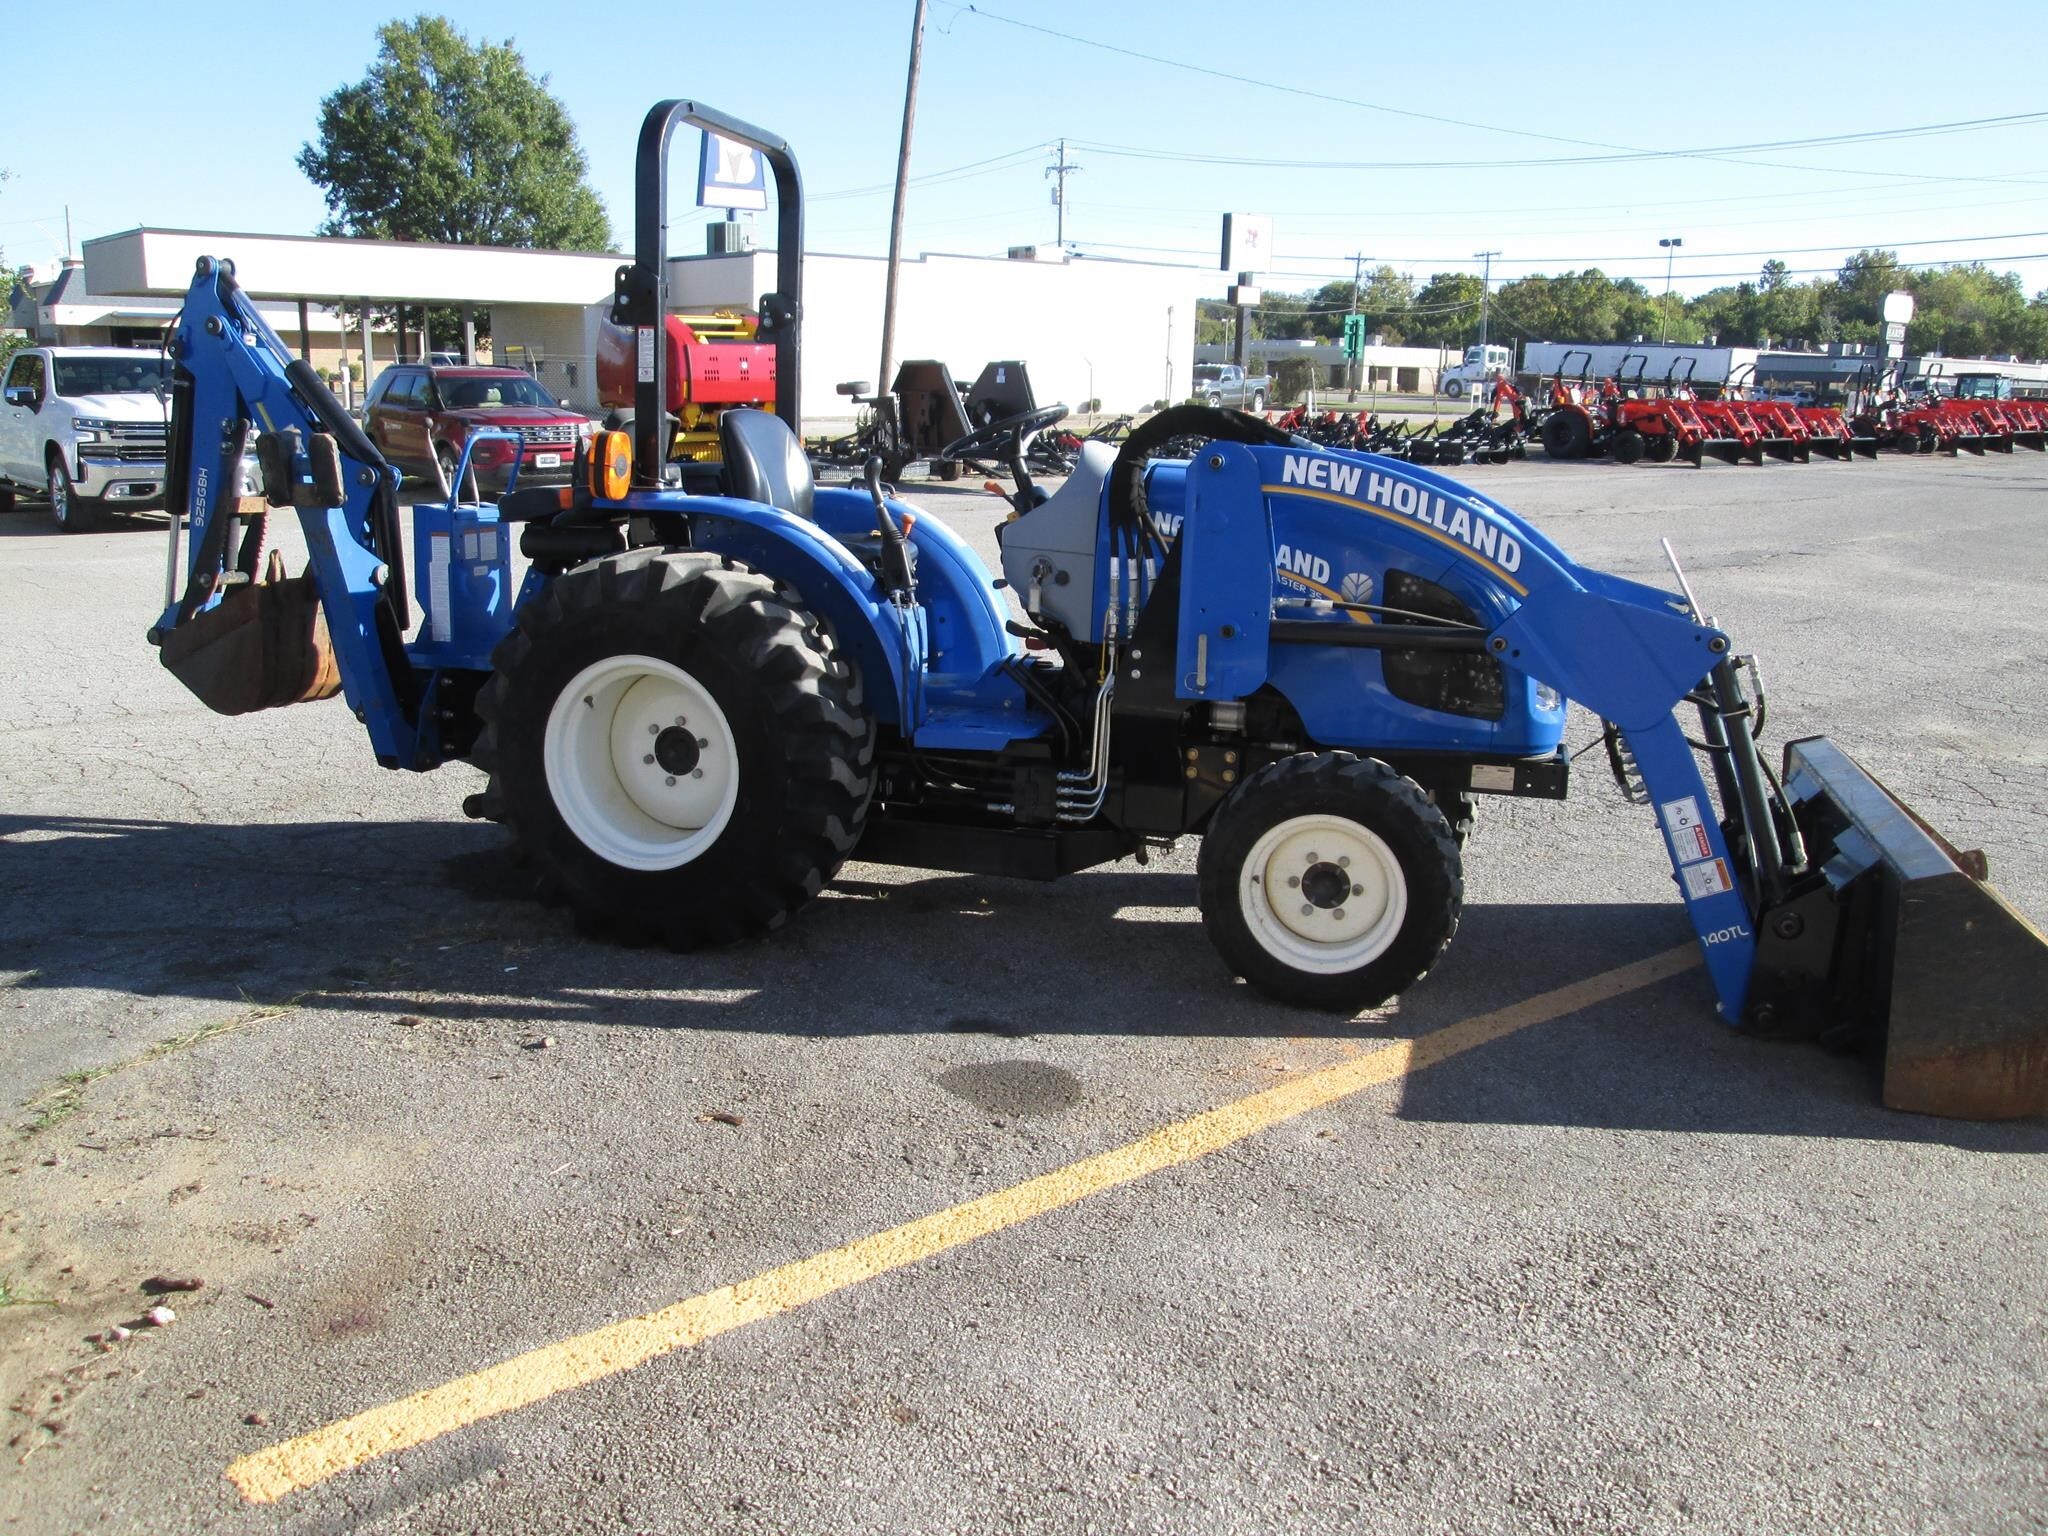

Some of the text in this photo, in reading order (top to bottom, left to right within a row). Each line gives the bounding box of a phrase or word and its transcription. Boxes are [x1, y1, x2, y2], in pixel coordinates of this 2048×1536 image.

[195, 467, 208, 527] 925GBH
[1282, 455, 1521, 573] NEW HOLLAND
[1154, 511, 1330, 584] NE AND
[1280, 576, 1306, 593] STER
[1697, 832, 1709, 855] DANGER
